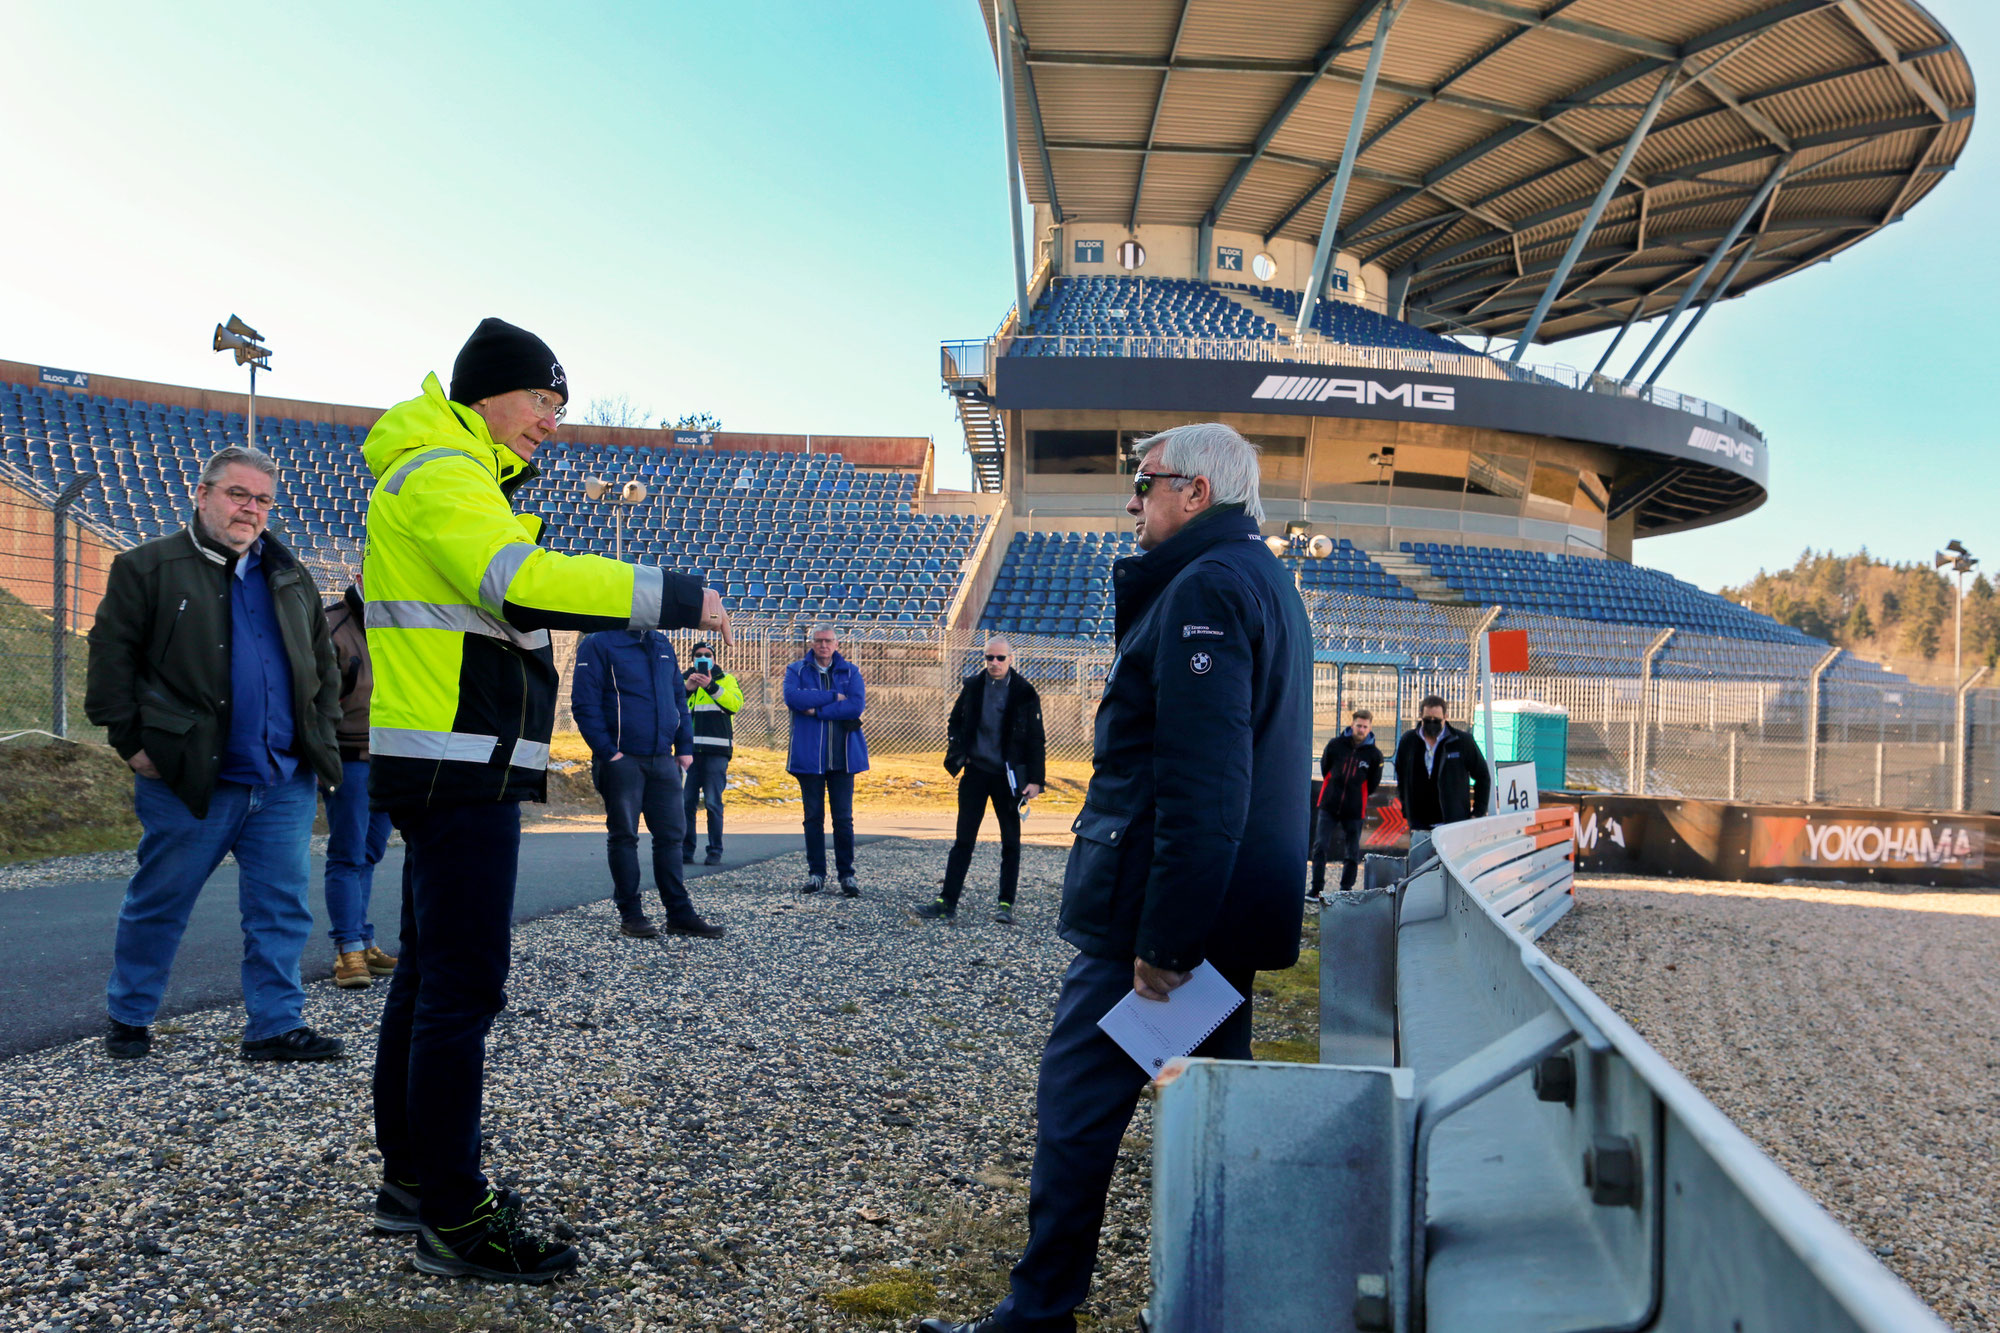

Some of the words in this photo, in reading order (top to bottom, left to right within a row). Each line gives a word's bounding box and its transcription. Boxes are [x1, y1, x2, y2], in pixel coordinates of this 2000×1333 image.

[1219, 248, 1241, 256] BLOCK
[1225, 256, 1236, 269] K
[43, 374, 69, 384] BLOCK
[73, 374, 84, 386] A
[1315, 378, 1455, 411] AMG
[1712, 433, 1754, 467] AMG
[1507, 779, 1529, 811] 4a
[1806, 824, 1971, 865] YOKOHAMA
